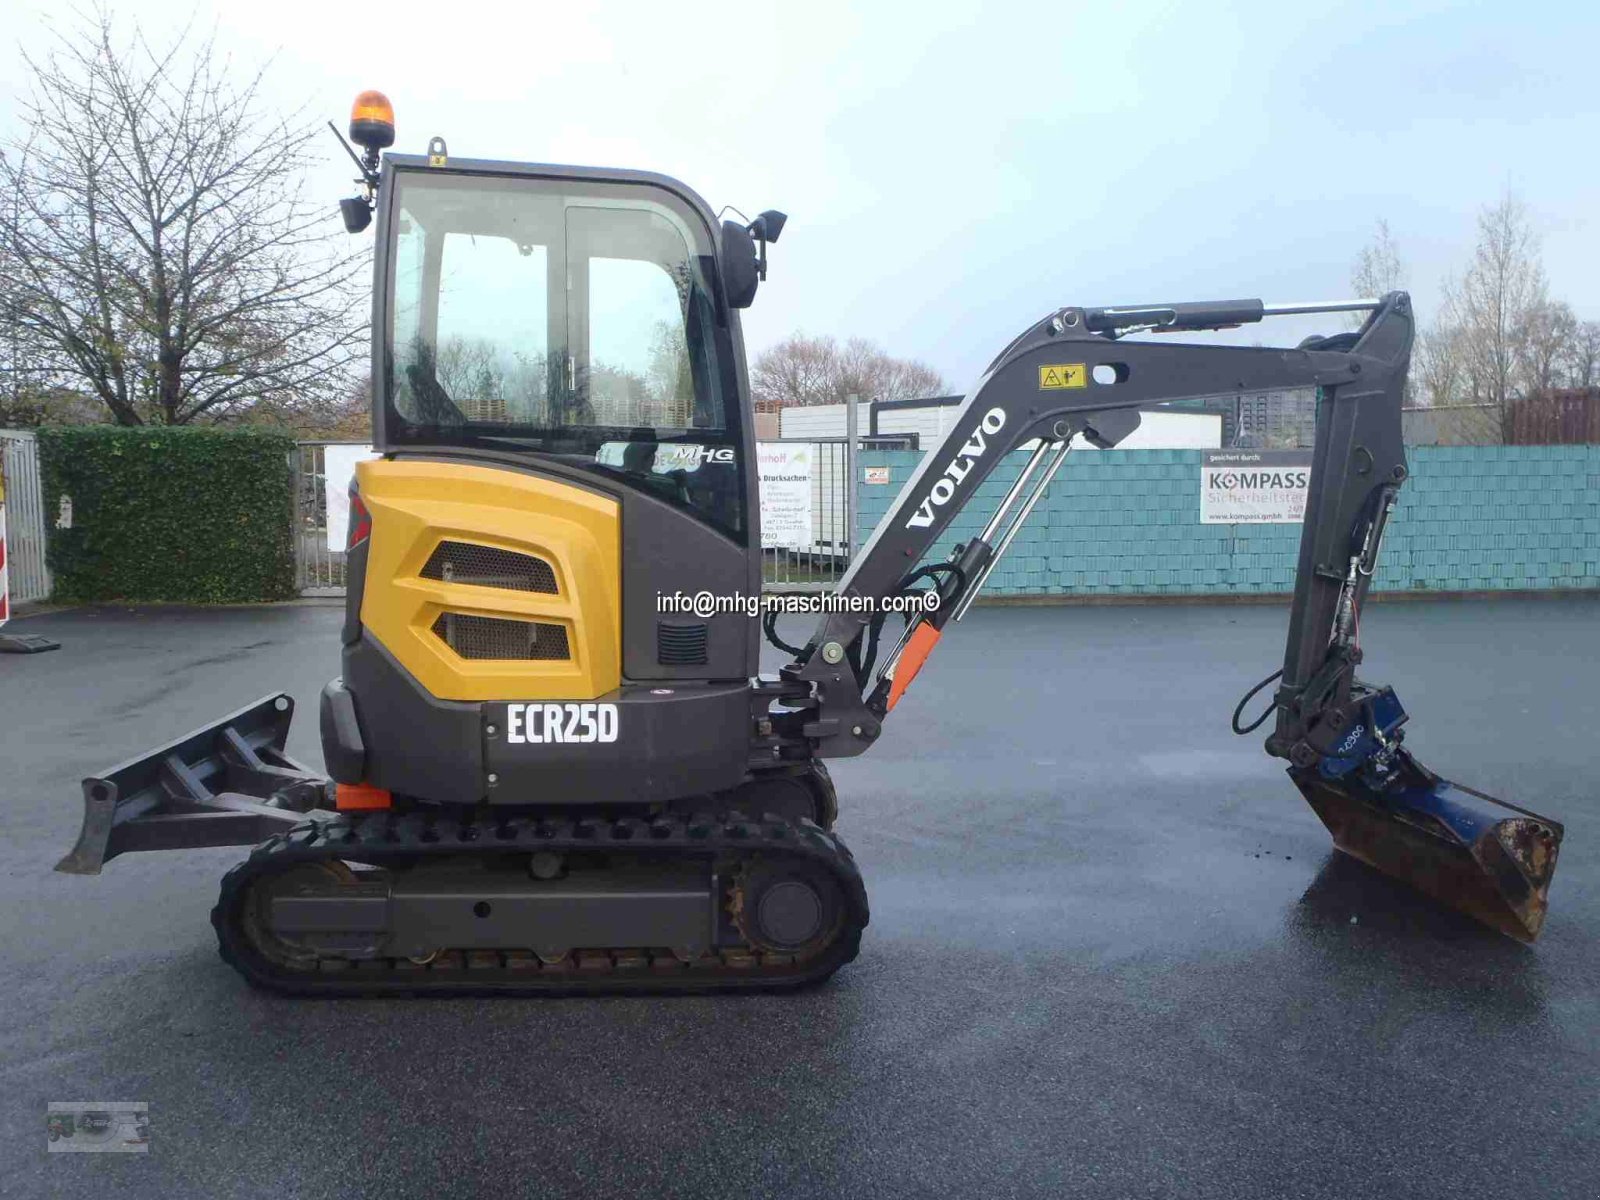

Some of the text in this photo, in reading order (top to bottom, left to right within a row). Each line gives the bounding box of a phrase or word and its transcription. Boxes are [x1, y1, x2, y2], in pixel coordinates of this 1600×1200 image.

[673, 445, 734, 462] MHG
[1209, 454, 1240, 462] gesichert
[905, 407, 1006, 529] VOLVO
[1209, 472, 1307, 489] KOMPASS
[1209, 513, 1282, 521] www.kompass.gmbh
[507, 703, 619, 744] ECR25D
